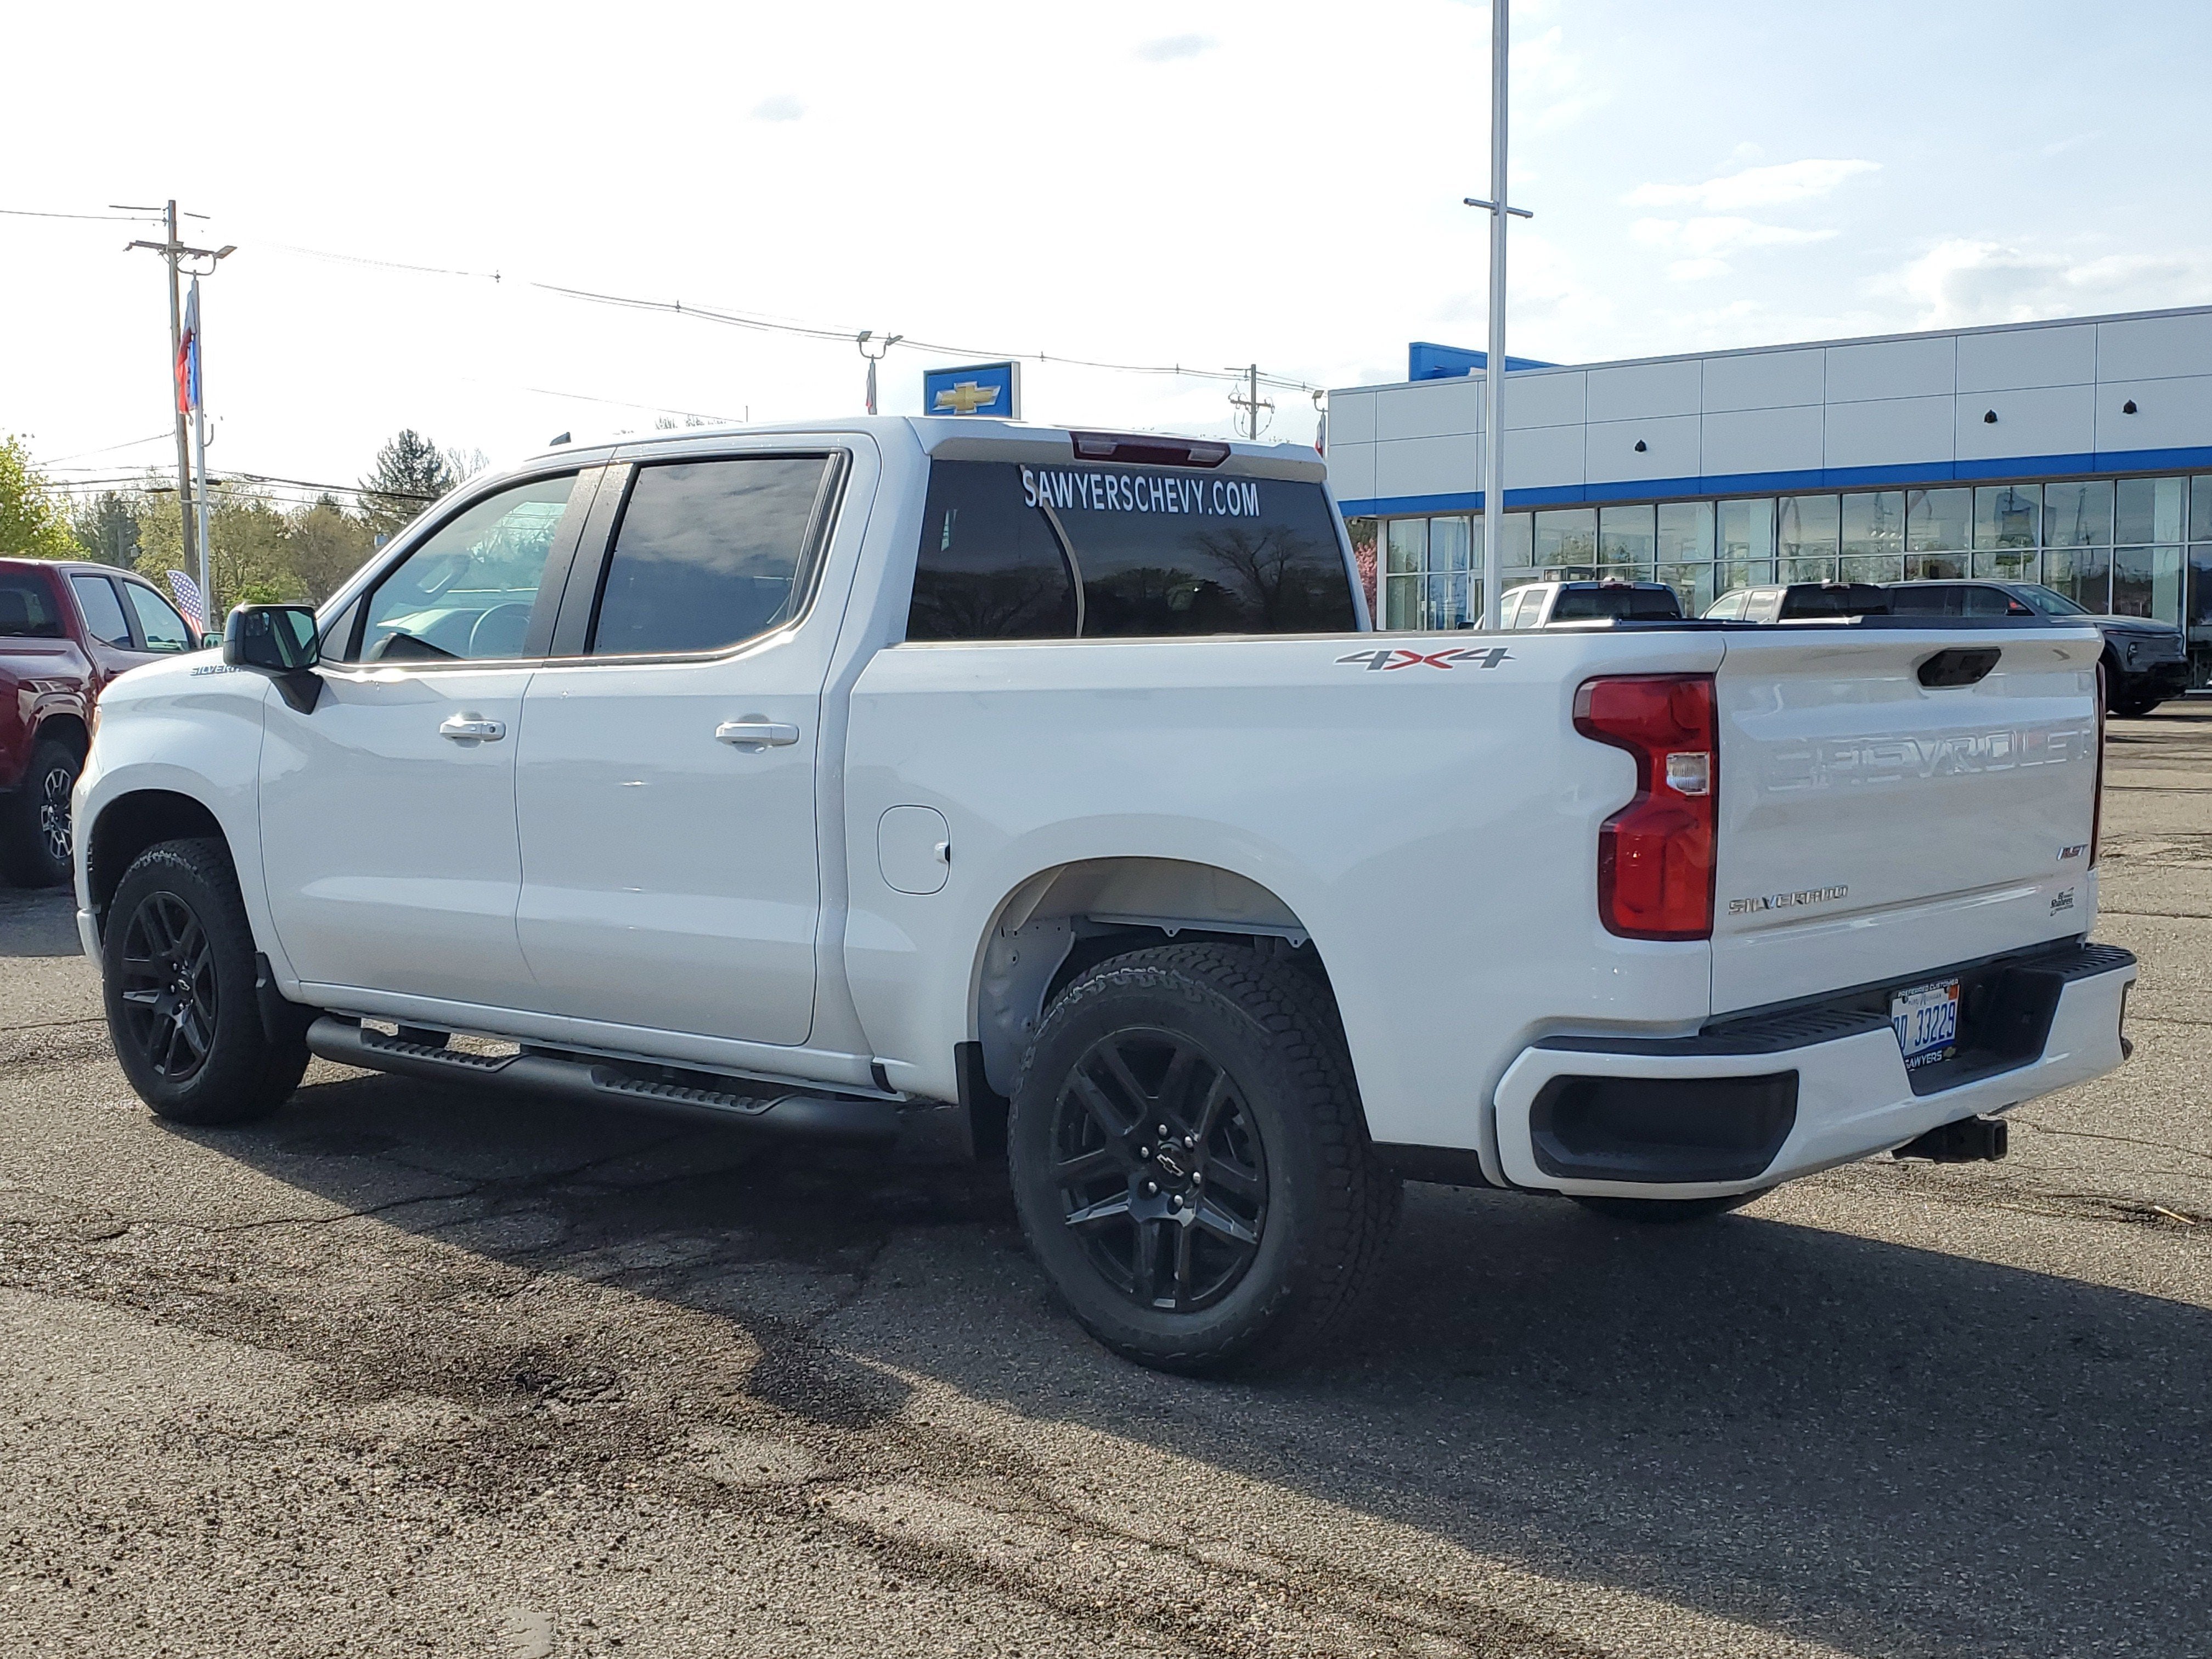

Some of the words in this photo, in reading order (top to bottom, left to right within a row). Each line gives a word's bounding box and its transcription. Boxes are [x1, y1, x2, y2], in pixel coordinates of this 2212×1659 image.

[1022, 469, 1260, 516] SAWYERSCHEVY.COM
[190, 664, 243, 676] SILVER
[1334, 647, 1516, 671] 4X4
[1728, 884, 1849, 915] SILVERADO
[1915, 1001, 1955, 1046] 33229
[1905, 1049, 1943, 1069] SAWYERS
